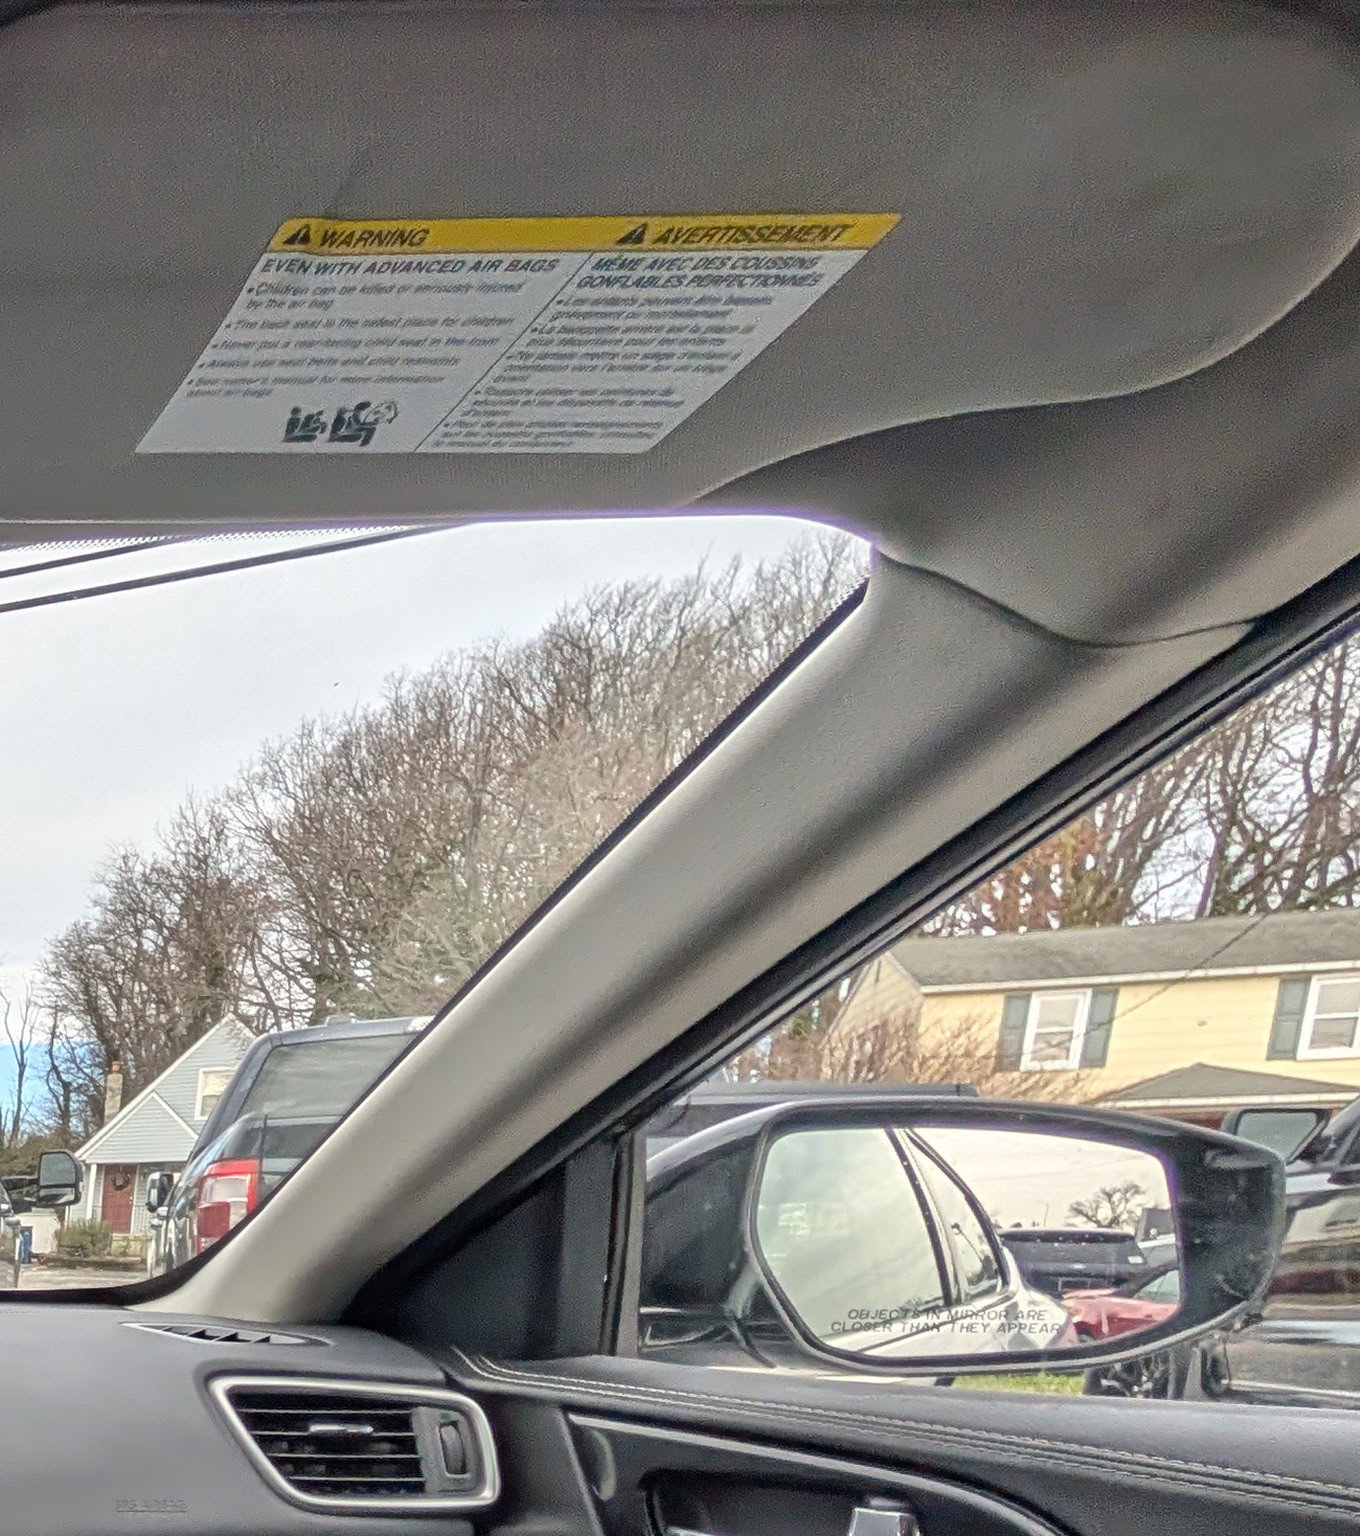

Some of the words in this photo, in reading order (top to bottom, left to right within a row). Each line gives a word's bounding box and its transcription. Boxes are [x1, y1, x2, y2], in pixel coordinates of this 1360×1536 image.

[320, 229, 430, 248] WARNING
[652, 224, 854, 245] AVERTISSEMENT
[261, 260, 312, 274] EVEN
[315, 261, 361, 276] WITH
[365, 260, 466, 275] ADVANCED
[471, 259, 499, 273] AIR
[504, 258, 560, 273] BAGS
[847, 1308, 921, 1321] OBJECTS
[926, 1309, 943, 1320] IN
[946, 1309, 1009, 1321] MIRROR
[1016, 1310, 1047, 1320] ARE
[831, 1321, 892, 1333] CLOSER
[901, 1322, 941, 1333] THAN
[951, 1322, 991, 1333] THEY
[996, 1323, 1062, 1334] APPEAR
